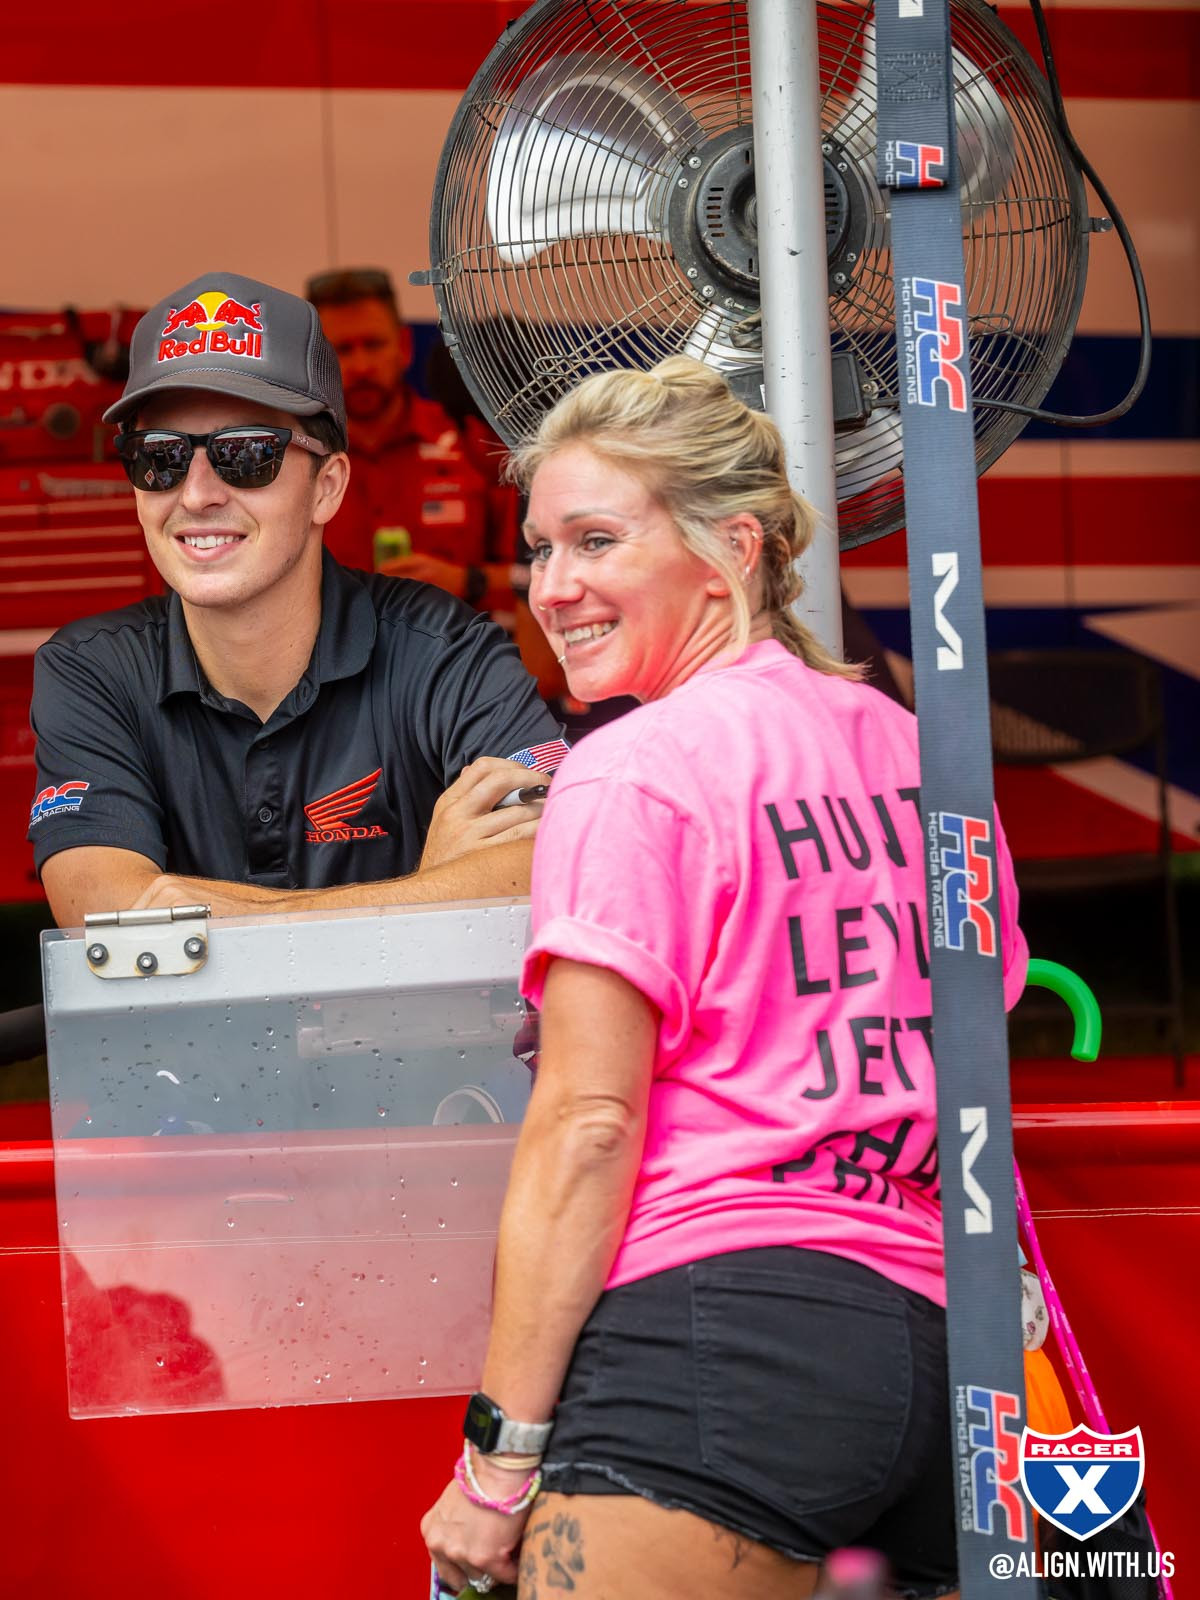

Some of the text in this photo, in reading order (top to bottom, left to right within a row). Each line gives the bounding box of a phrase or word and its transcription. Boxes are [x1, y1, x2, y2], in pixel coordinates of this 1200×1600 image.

[157, 330, 263, 363] Red Bull
[901, 277, 917, 404] Honda RACING
[912, 276, 967, 412] HRC
[43, 805, 81, 819] RACING
[304, 825, 389, 843] HONDA
[931, 879, 945, 948] RACING
[939, 811, 997, 957] HRC
[960, 1457, 973, 1532] RACING
